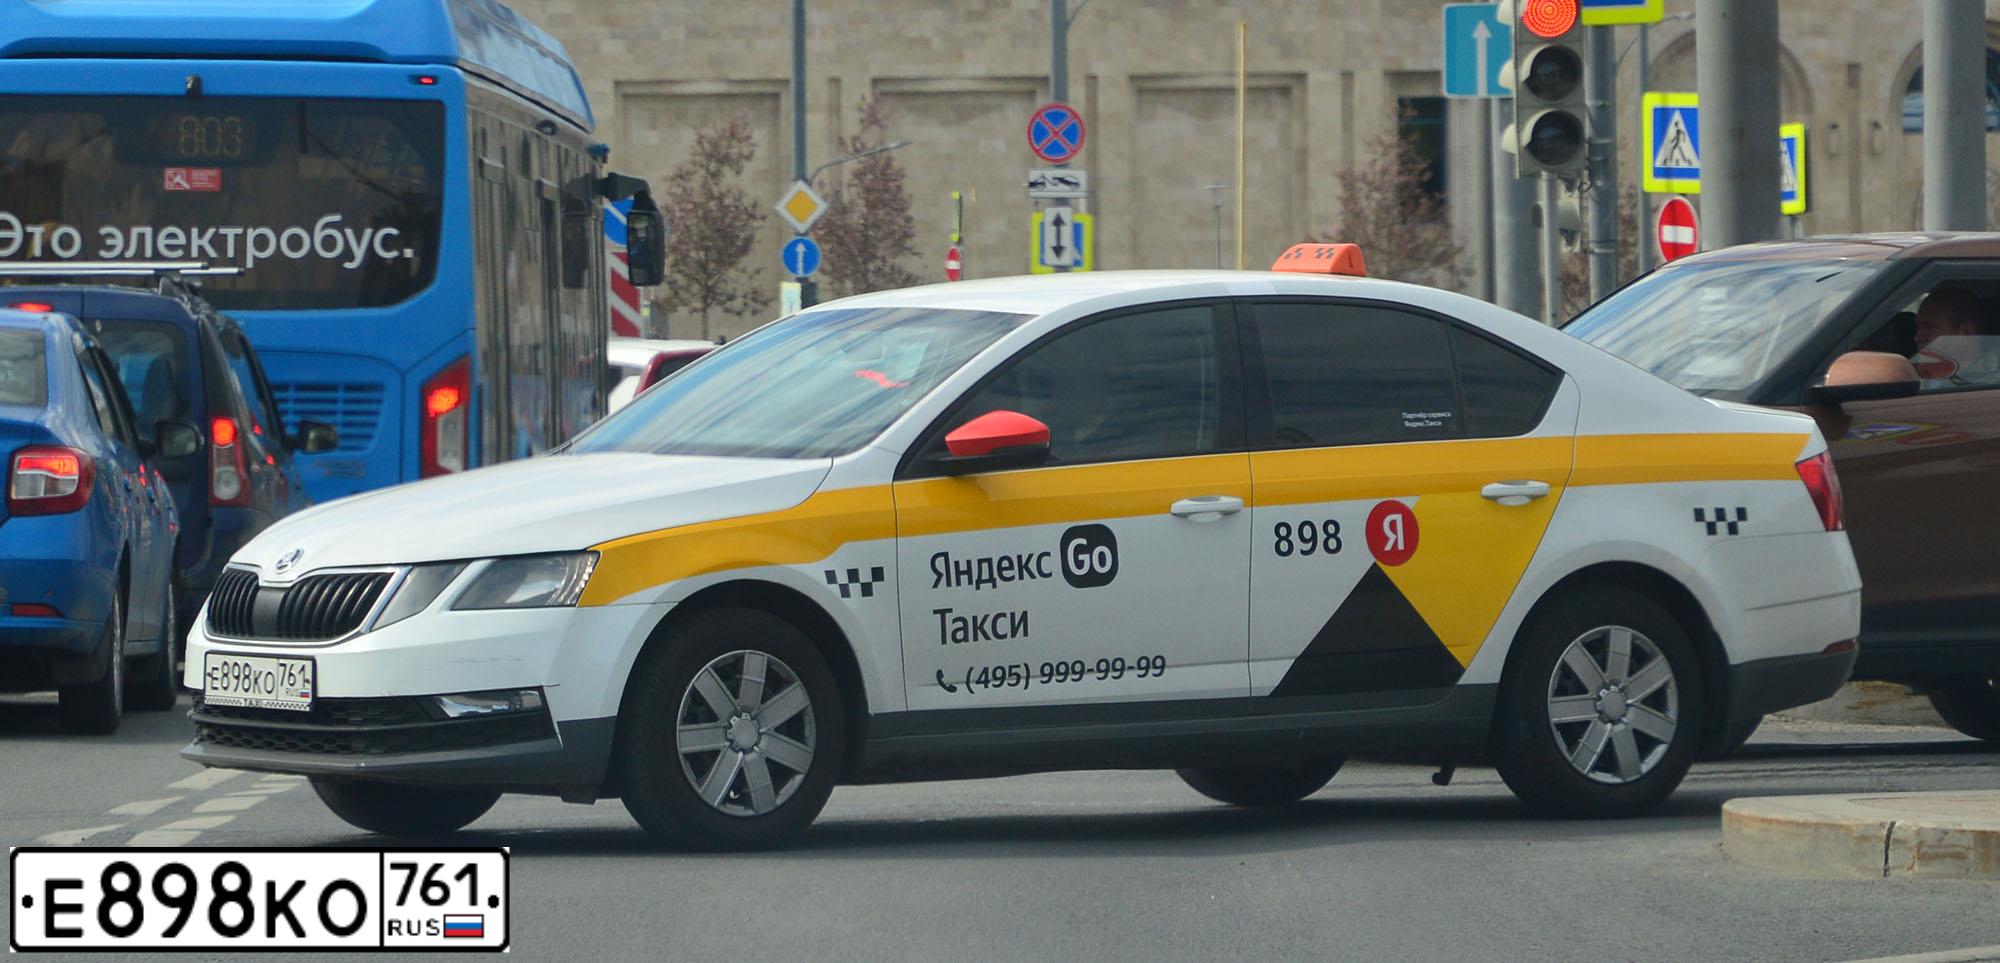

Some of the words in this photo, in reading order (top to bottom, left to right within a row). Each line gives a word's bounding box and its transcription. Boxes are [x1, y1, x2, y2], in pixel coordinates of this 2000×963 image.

[180, 115, 242, 157] 803
[0, 210, 82, 258] Это
[98, 214, 415, 269] электробус.
[1274, 519, 1343, 557] 898
[1382, 513, 1405, 552] Я
[929, 551, 1053, 590] Яндекс
[1067, 537, 1113, 576] Go
[932, 607, 1030, 646] Такси
[279, 663, 306, 688] 761
[965, 662, 1031, 694] (495)
[1039, 655, 1166, 684] 999-99-99
